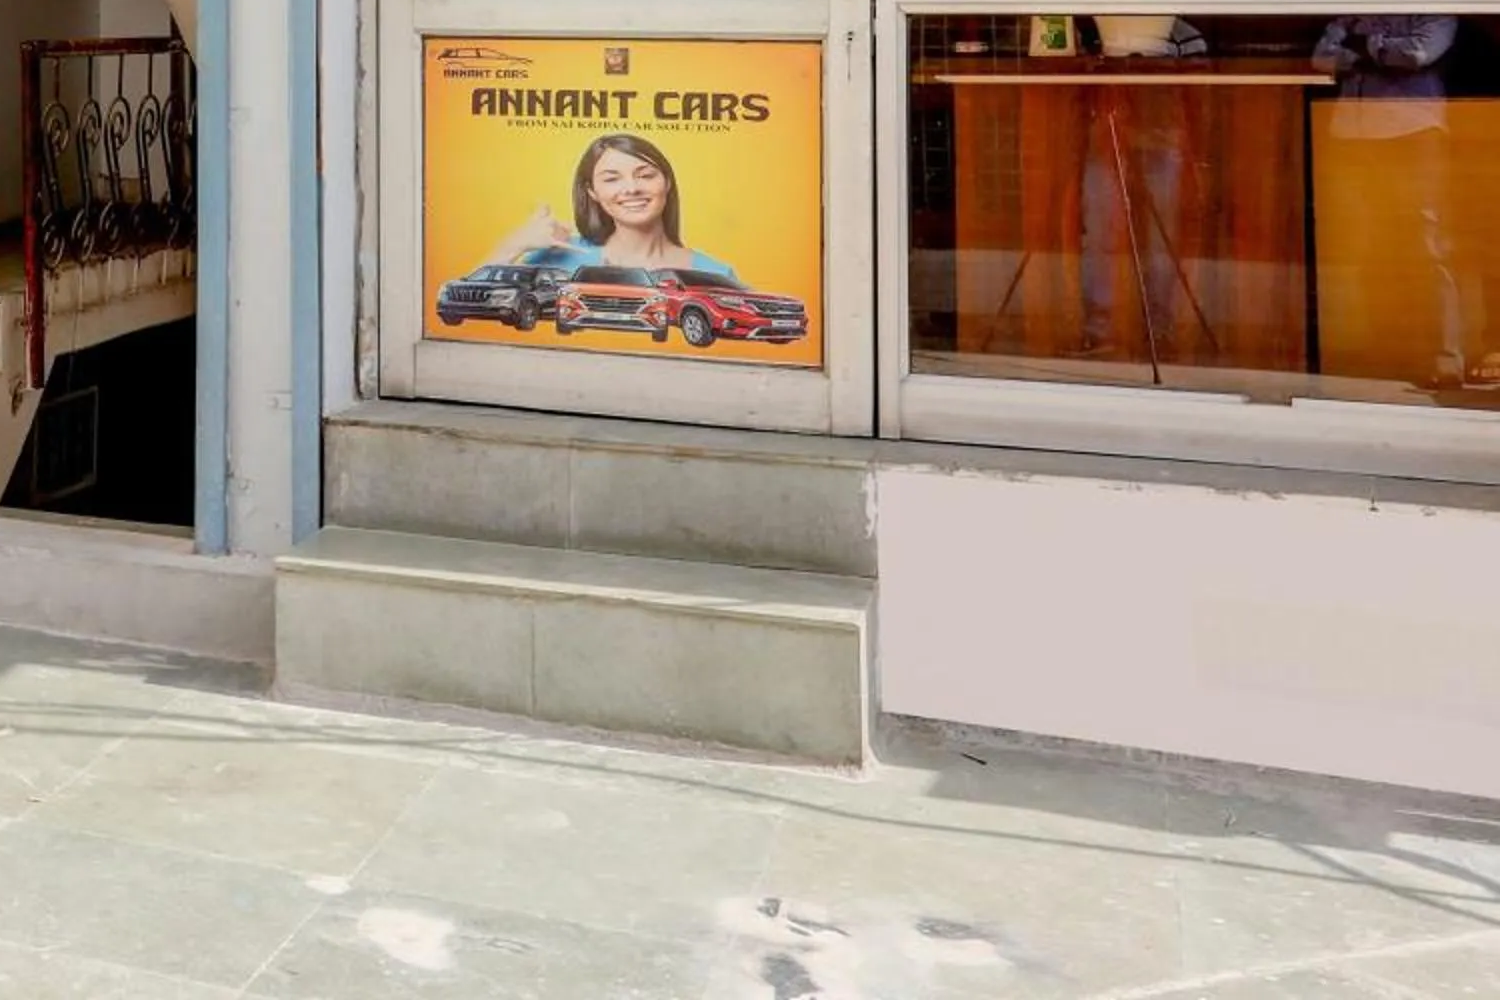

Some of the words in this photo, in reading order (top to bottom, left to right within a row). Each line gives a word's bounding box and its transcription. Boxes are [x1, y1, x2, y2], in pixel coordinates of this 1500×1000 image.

[443, 68, 491, 79] ANNANT
[495, 69, 529, 80] CARS
[471, 87, 638, 119] ANNANT
[653, 91, 771, 123] CARS
[506, 119, 547, 129] FROM
